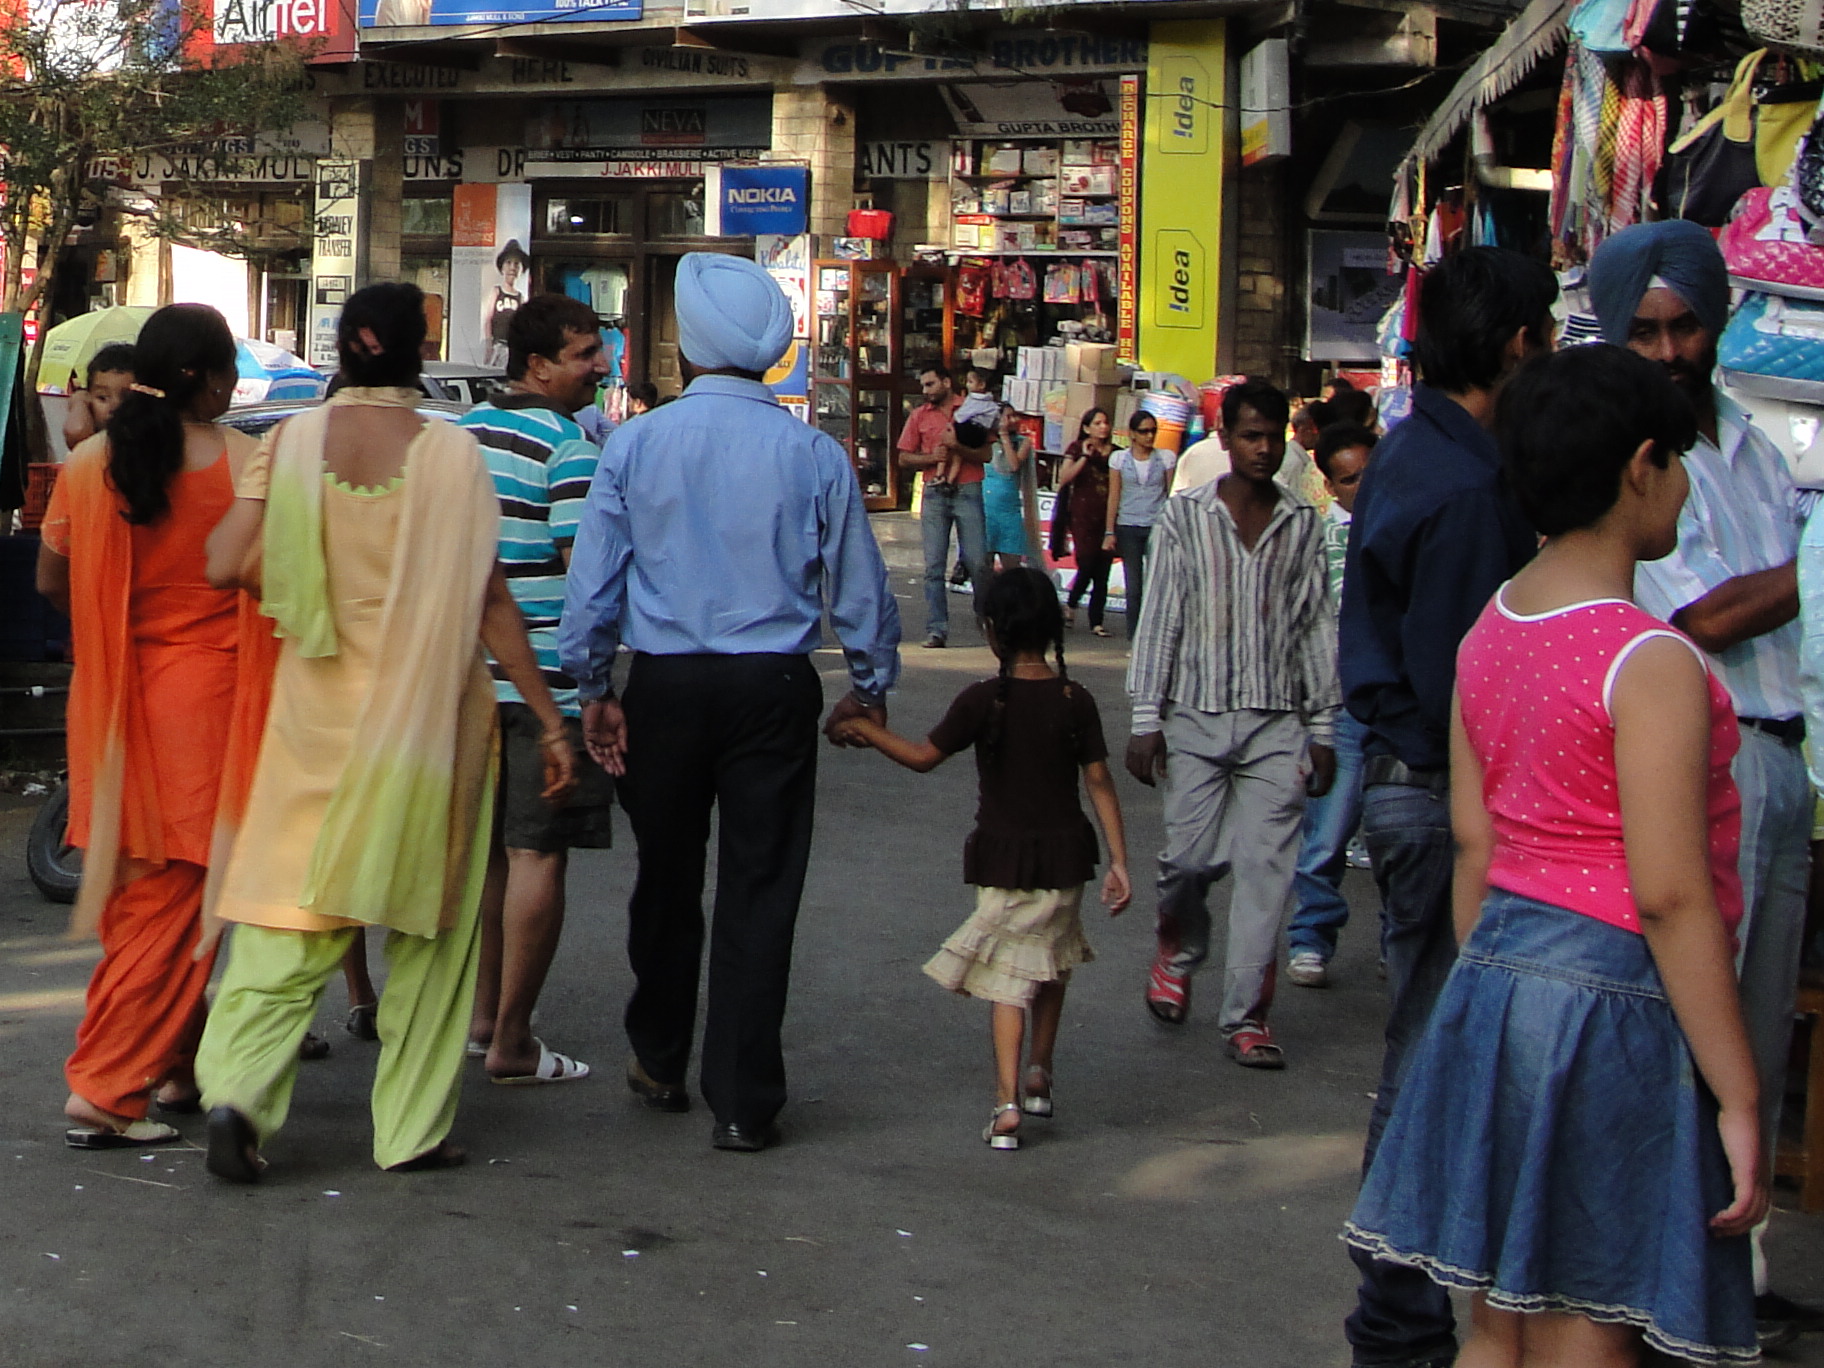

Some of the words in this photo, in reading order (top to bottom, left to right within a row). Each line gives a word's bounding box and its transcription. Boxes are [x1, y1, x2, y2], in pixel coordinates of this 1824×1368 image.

[641, 48, 702, 74] CIVILIAN
[706, 53, 749, 77] SUITS
[363, 63, 461, 89] EXECUTED
[512, 59, 573, 84] HERE
[643, 110, 703, 131] NEVA
[997, 123, 1052, 133] GUPTA
[1121, 82, 1135, 159] RECHARGE
[528, 150, 550, 159] BRIEF
[555, 150, 574, 159] VEST
[580, 150, 605, 159] PANTY
[611, 150, 651, 159] CAMISOLE
[656, 150, 702, 159] BRASSIERE
[708, 149, 738, 159] ACTIVE
[136, 157, 154, 180] J.
[666, 161, 706, 177] MULL
[728, 188, 797, 204] NOKIA
[1119, 167, 1134, 234] COUPONS
[318, 238, 353, 257] TRANSFER
[1118, 243, 1135, 329] AVAILABLE
